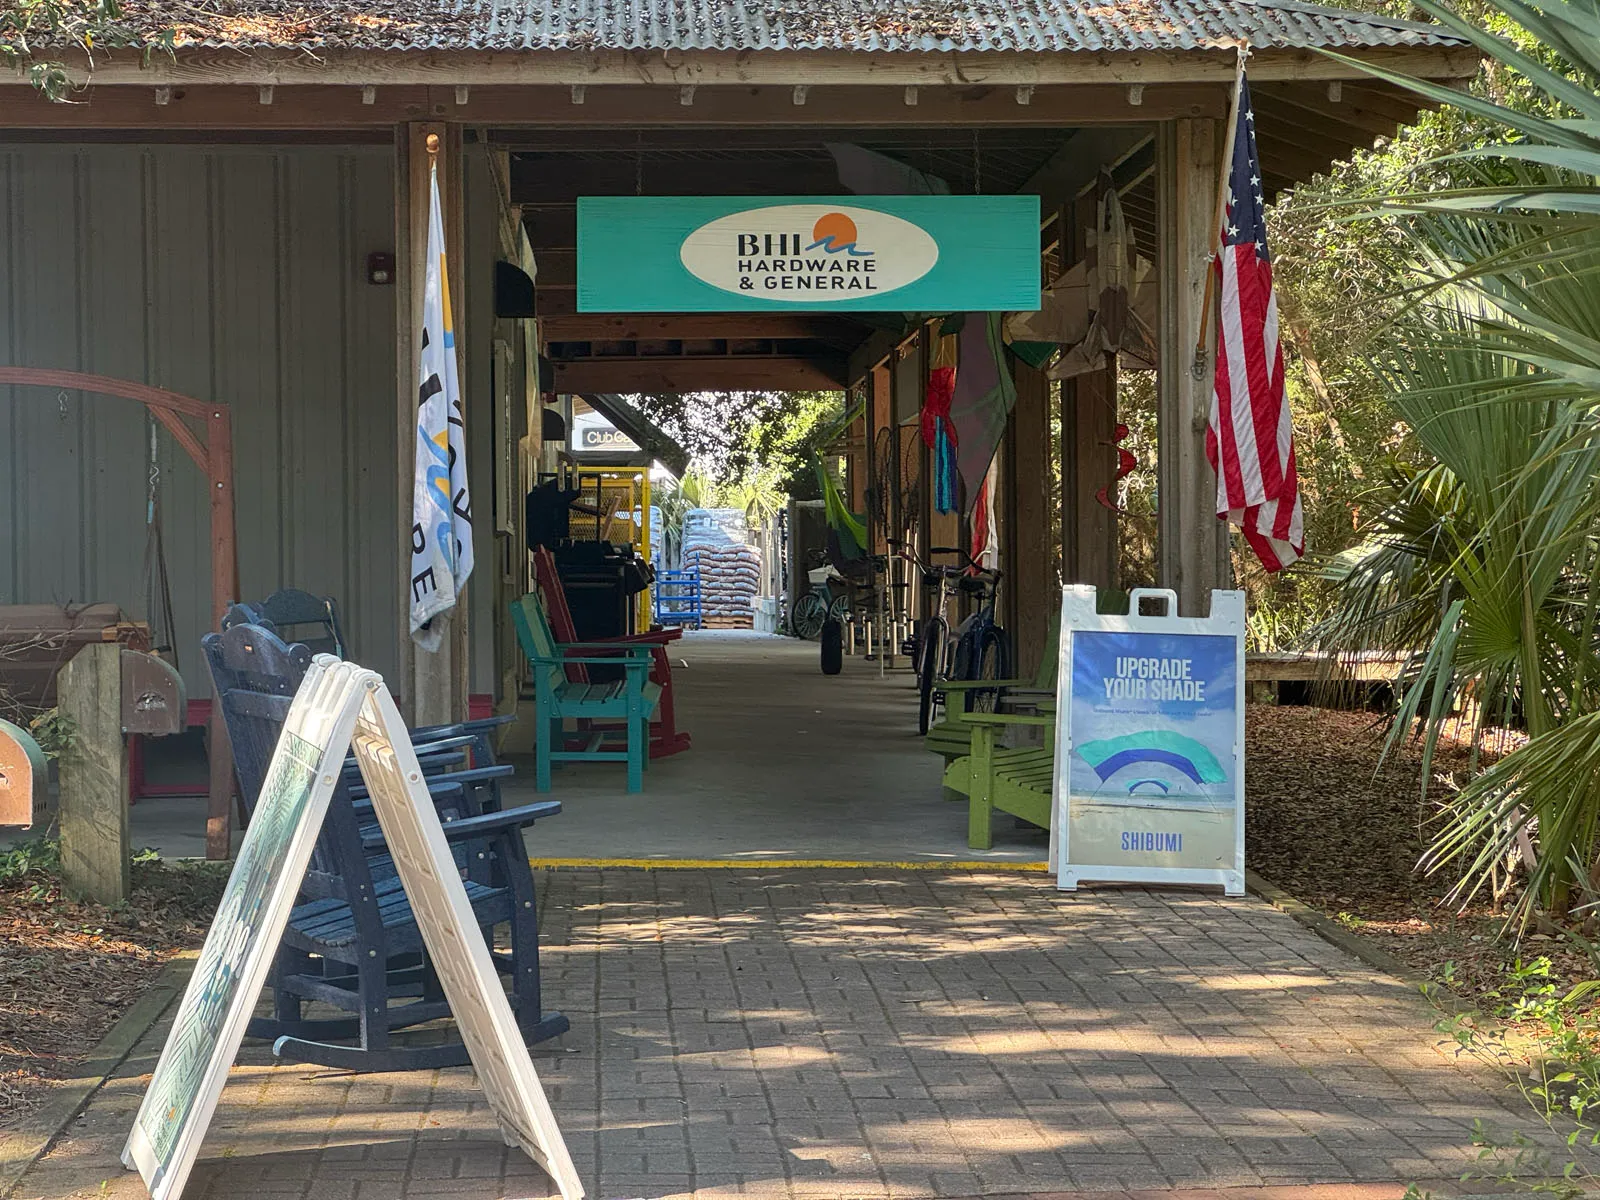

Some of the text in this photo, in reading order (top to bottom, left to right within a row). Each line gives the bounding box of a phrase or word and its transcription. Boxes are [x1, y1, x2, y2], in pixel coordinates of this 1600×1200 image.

[737, 233, 801, 256] BHI
[738, 259, 876, 273] HARDWARE
[739, 275, 878, 290] & GENERAL
[587, 431, 613, 444] Club
[1116, 656, 1192, 680] UPGRADE
[1103, 677, 1206, 702] YOUR SHADE
[1121, 831, 1183, 852] SHIBUMI
